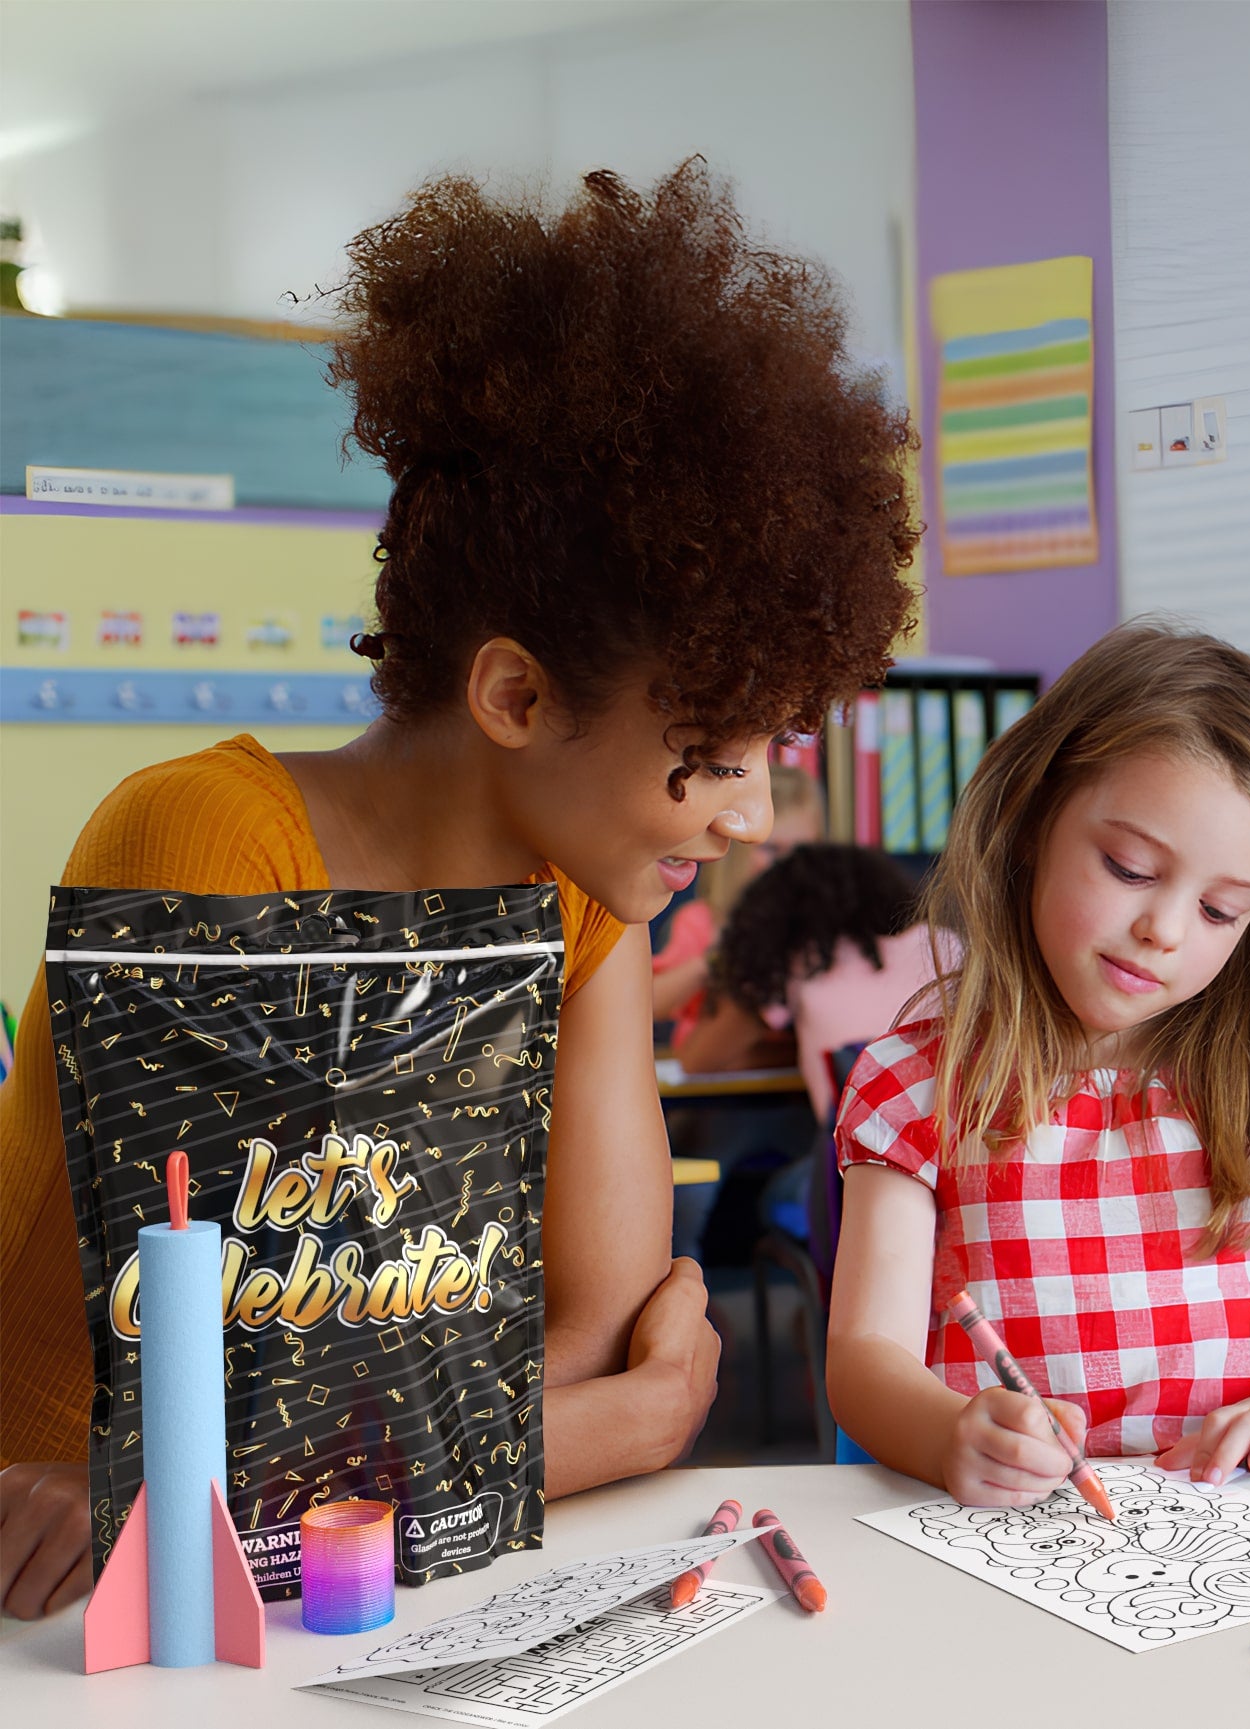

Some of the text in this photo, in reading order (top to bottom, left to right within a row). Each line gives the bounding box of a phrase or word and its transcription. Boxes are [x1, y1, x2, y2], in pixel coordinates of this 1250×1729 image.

[234, 1133, 418, 1234] let's
[109, 1222, 508, 1342] Clebrate!
[430, 1503, 483, 1534] CAUTION
[242, 1530, 301, 1554] WARNI
[438, 1536, 451, 1545] are
[452, 1532, 467, 1543] not
[441, 1546, 472, 1558] devices
